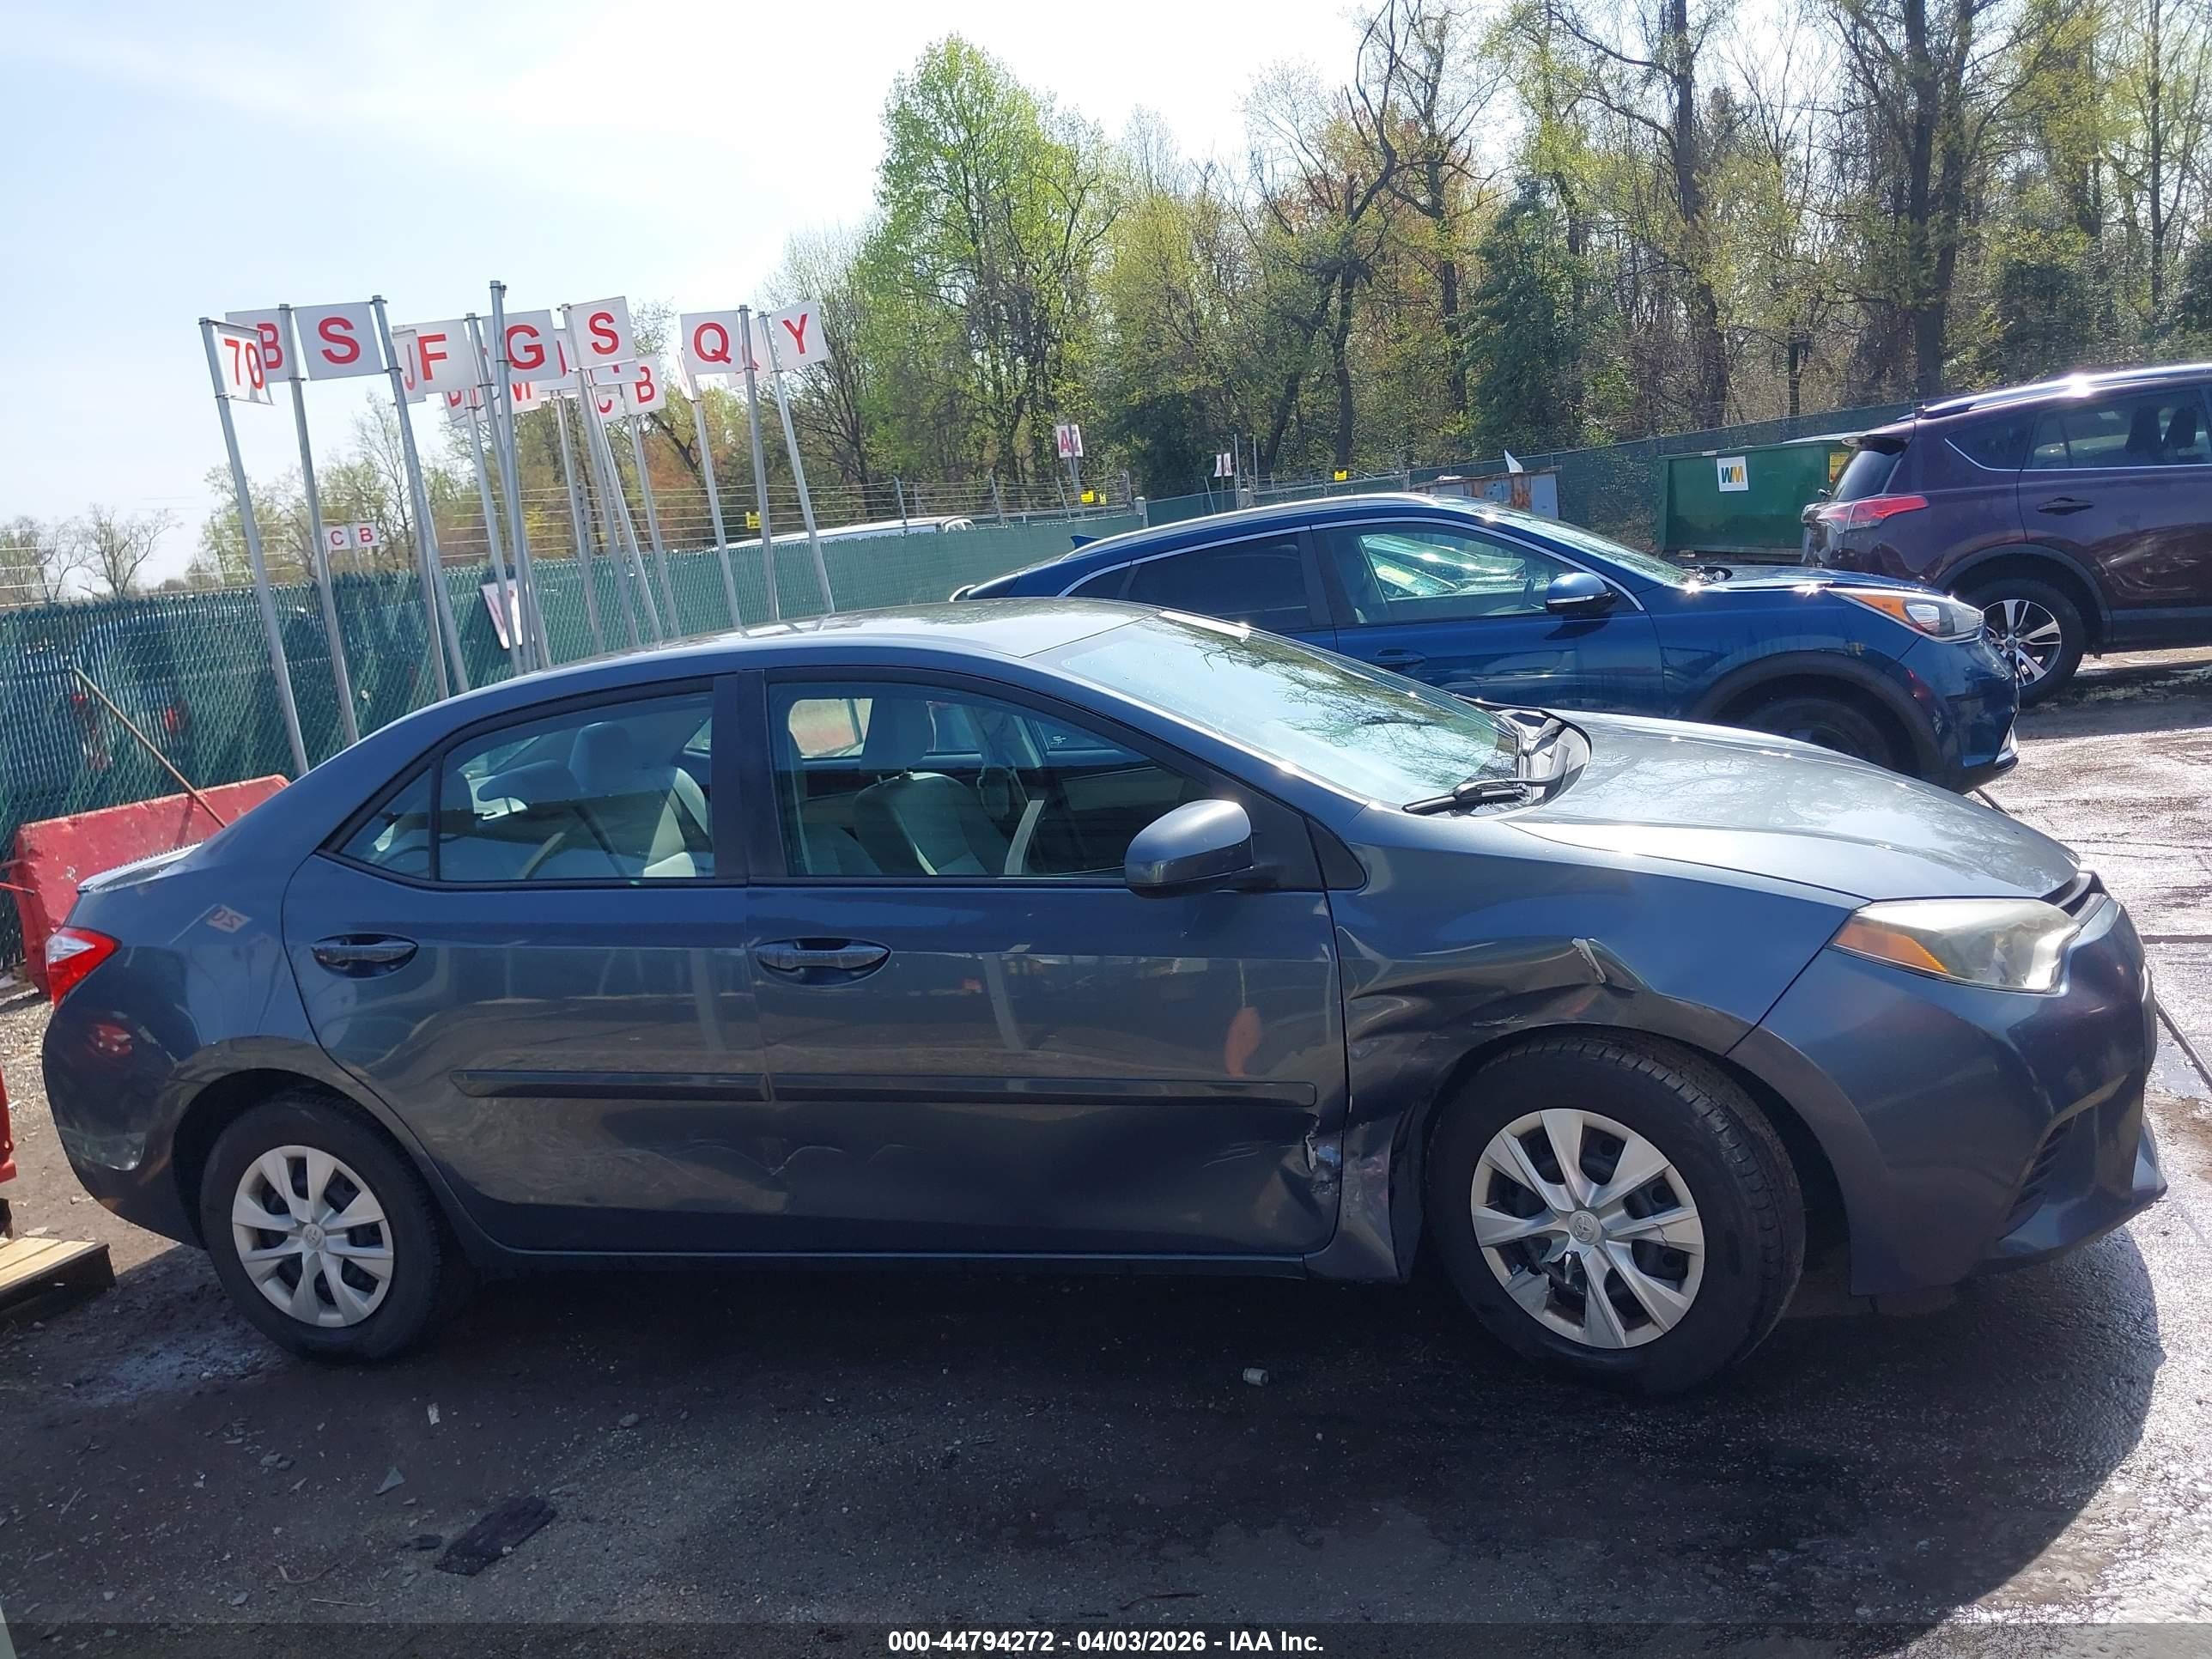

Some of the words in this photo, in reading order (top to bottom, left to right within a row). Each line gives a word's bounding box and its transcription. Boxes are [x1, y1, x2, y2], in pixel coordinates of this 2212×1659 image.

[257, 322, 283, 369] B
[318, 316, 361, 364] S
[505, 324, 546, 370] G
[588, 311, 620, 356] S
[693, 322, 732, 365] Q
[781, 313, 808, 355] Y
[223, 338, 264, 390] 70
[417, 333, 447, 380] F
[1721, 465, 1744, 483] WM
[330, 530, 344, 545] C
[358, 527, 373, 543] B
